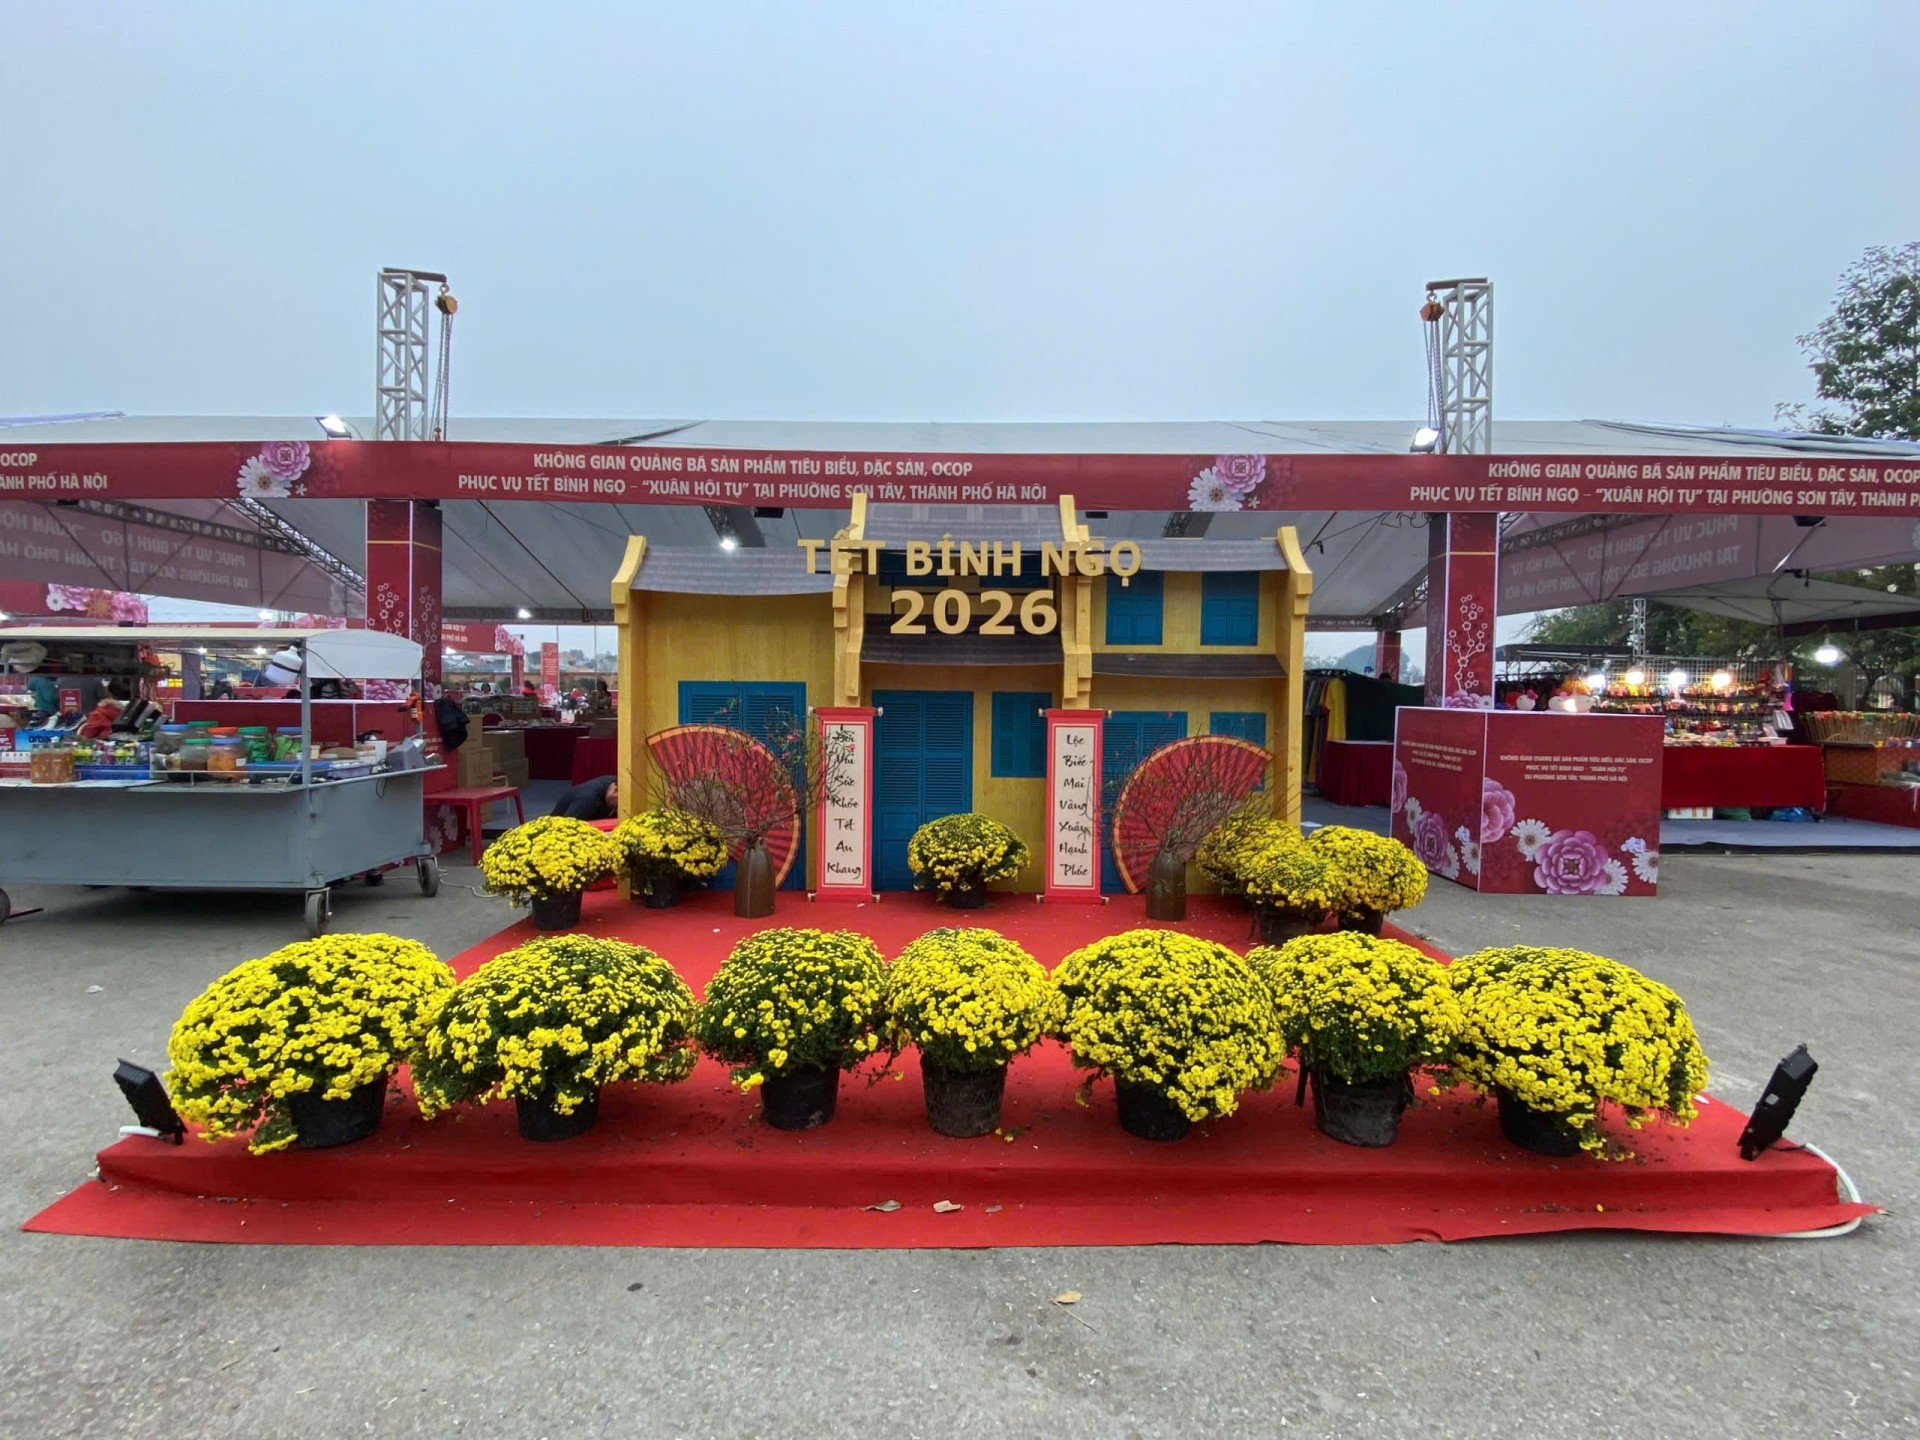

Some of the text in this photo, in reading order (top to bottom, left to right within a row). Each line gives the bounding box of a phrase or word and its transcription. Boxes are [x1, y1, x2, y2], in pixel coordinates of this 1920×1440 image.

[0, 452, 38, 467] OCOP
[533, 451, 973, 478] KHÔNG GIAN QUẢNG BÁ SẢN PHẨM TIÊU BIỂU, ĐẶC SẢN, OCOP
[1488, 460, 1920, 484] KHÔNG GIAN QUẢNG BÁ SẢN PHẨM TIÊU BIỂU, ĐẶC SẢN, OCOP
[28, 471, 57, 490] PHỐ
[60, 473, 80, 489] HÀ
[83, 472, 108, 491] NỘI
[458, 474, 498, 492] PHỤC
[501, 475, 522, 493] VỤ
[525, 472, 550, 492] TẾT
[554, 475, 589, 493] BÍNH
[593, 478, 626, 496] NGỌ
[642, 478, 690, 496] “XUÂN
[694, 478, 721, 498] HỘI
[724, 481, 749, 499] TỤ”
[753, 482, 775, 500] TẠI
[778, 481, 841, 499] PHƯỜNG
[844, 482, 874, 500] SƠN
[877, 481, 907, 501] TÂY,
[909, 482, 958, 500] THÀNH
[962, 481, 993, 500] PHỐ
[996, 482, 1017, 500] HÀ
[1020, 482, 1047, 502] NỘI
[1410, 485, 1450, 503] PHỤC
[1454, 486, 1475, 504] VỤ
[1478, 482, 1503, 502] TẾT
[1507, 484, 1543, 502] BÍNH
[1546, 487, 1579, 504] NGỌ
[1595, 486, 1643, 503] “XUÂN
[1647, 485, 1674, 505] HỘI
[1677, 488, 1703, 506] TỤ”
[1706, 489, 1728, 507] TẠI
[1731, 487, 1794, 505] PHƯỜNG
[1797, 489, 1827, 506] SƠN
[1830, 488, 1857, 508] TÂY,
[1860, 489, 1906, 507] THÀNH
[797, 523, 1142, 587] TẾT BÍNH NGỌ
[890, 589, 1058, 636] 2026
[1066, 733, 1084, 747] Lộc
[1062, 754, 1087, 767] Biếc
[834, 770, 855, 786] Sức
[1063, 777, 1085, 789] Mai
[1059, 799, 1088, 816] Vàng
[833, 818, 855, 831] Tết
[1058, 821, 1089, 833] Xuân
[835, 840, 853, 852] An
[1058, 841, 1087, 855] Hạnh
[827, 862, 861, 879] Khang
[1059, 863, 1088, 876] Phúc
